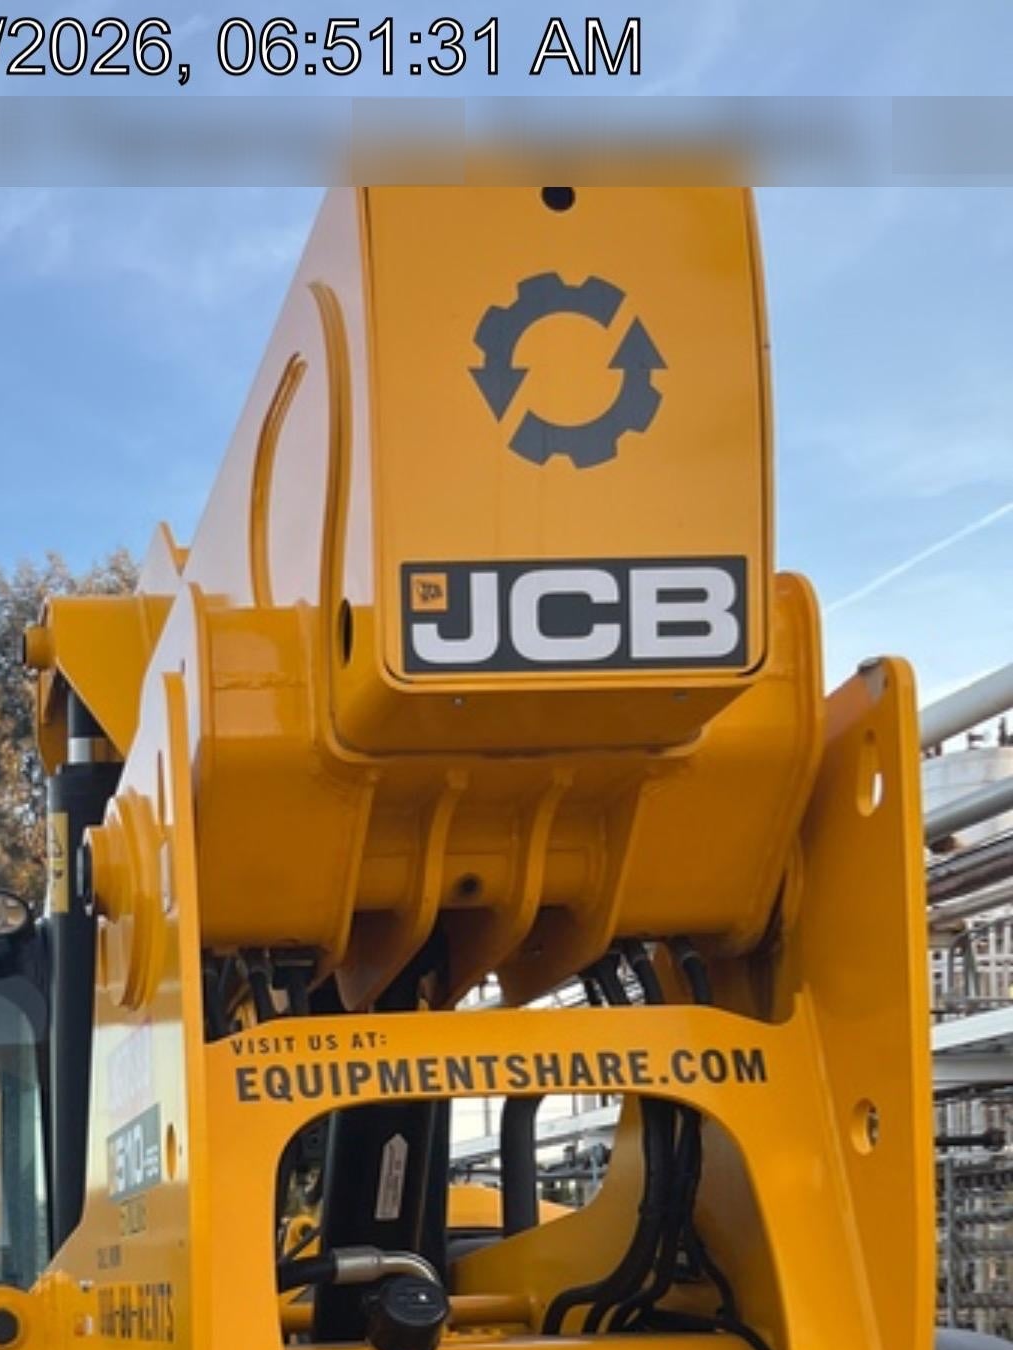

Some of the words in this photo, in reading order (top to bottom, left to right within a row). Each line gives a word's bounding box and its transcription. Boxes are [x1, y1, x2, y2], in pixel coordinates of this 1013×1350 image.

[412, 567, 739, 663] JCB
[230, 1036, 295, 1055] VISIT
[309, 1034, 338, 1051] US
[351, 1031, 387, 1049] AT:
[236, 1049, 767, 1103] EQUIPMENTSHARE.COM
